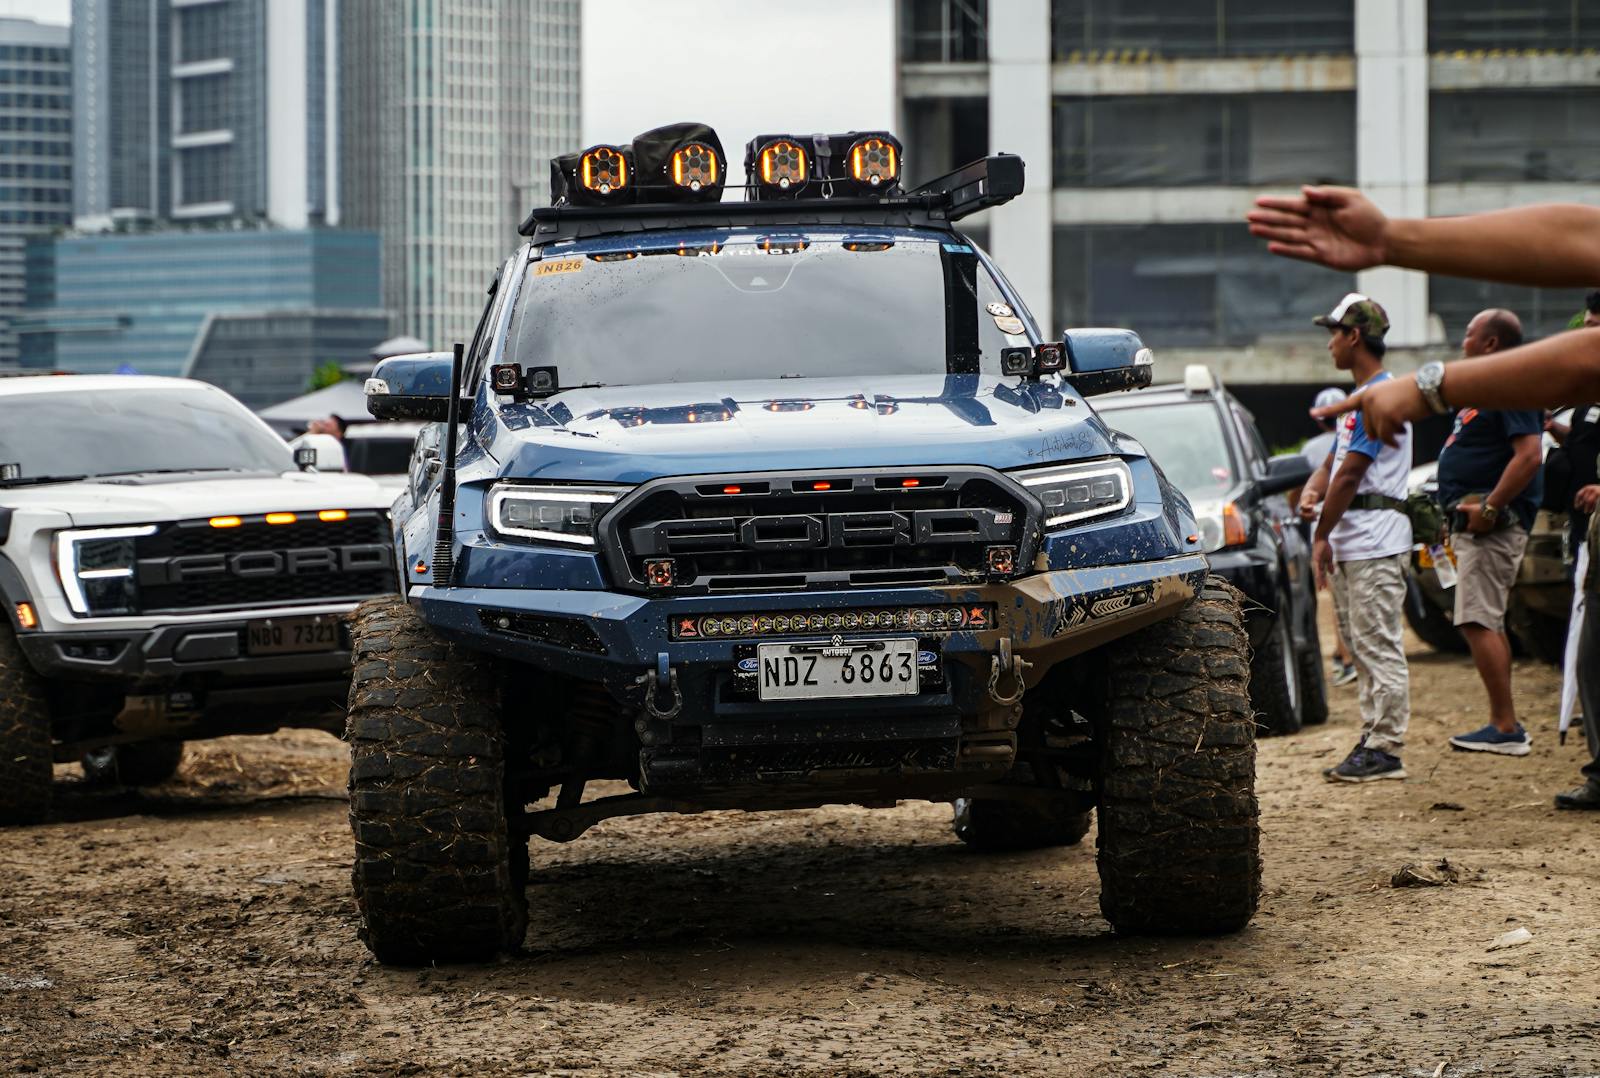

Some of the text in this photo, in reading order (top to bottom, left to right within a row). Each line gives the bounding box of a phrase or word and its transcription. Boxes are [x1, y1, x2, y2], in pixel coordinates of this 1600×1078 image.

[650, 507, 1006, 556] FORD
[168, 543, 393, 583] FORD
[251, 623, 336, 647] NBQ 7321
[764, 652, 912, 687] NDZ 6863
